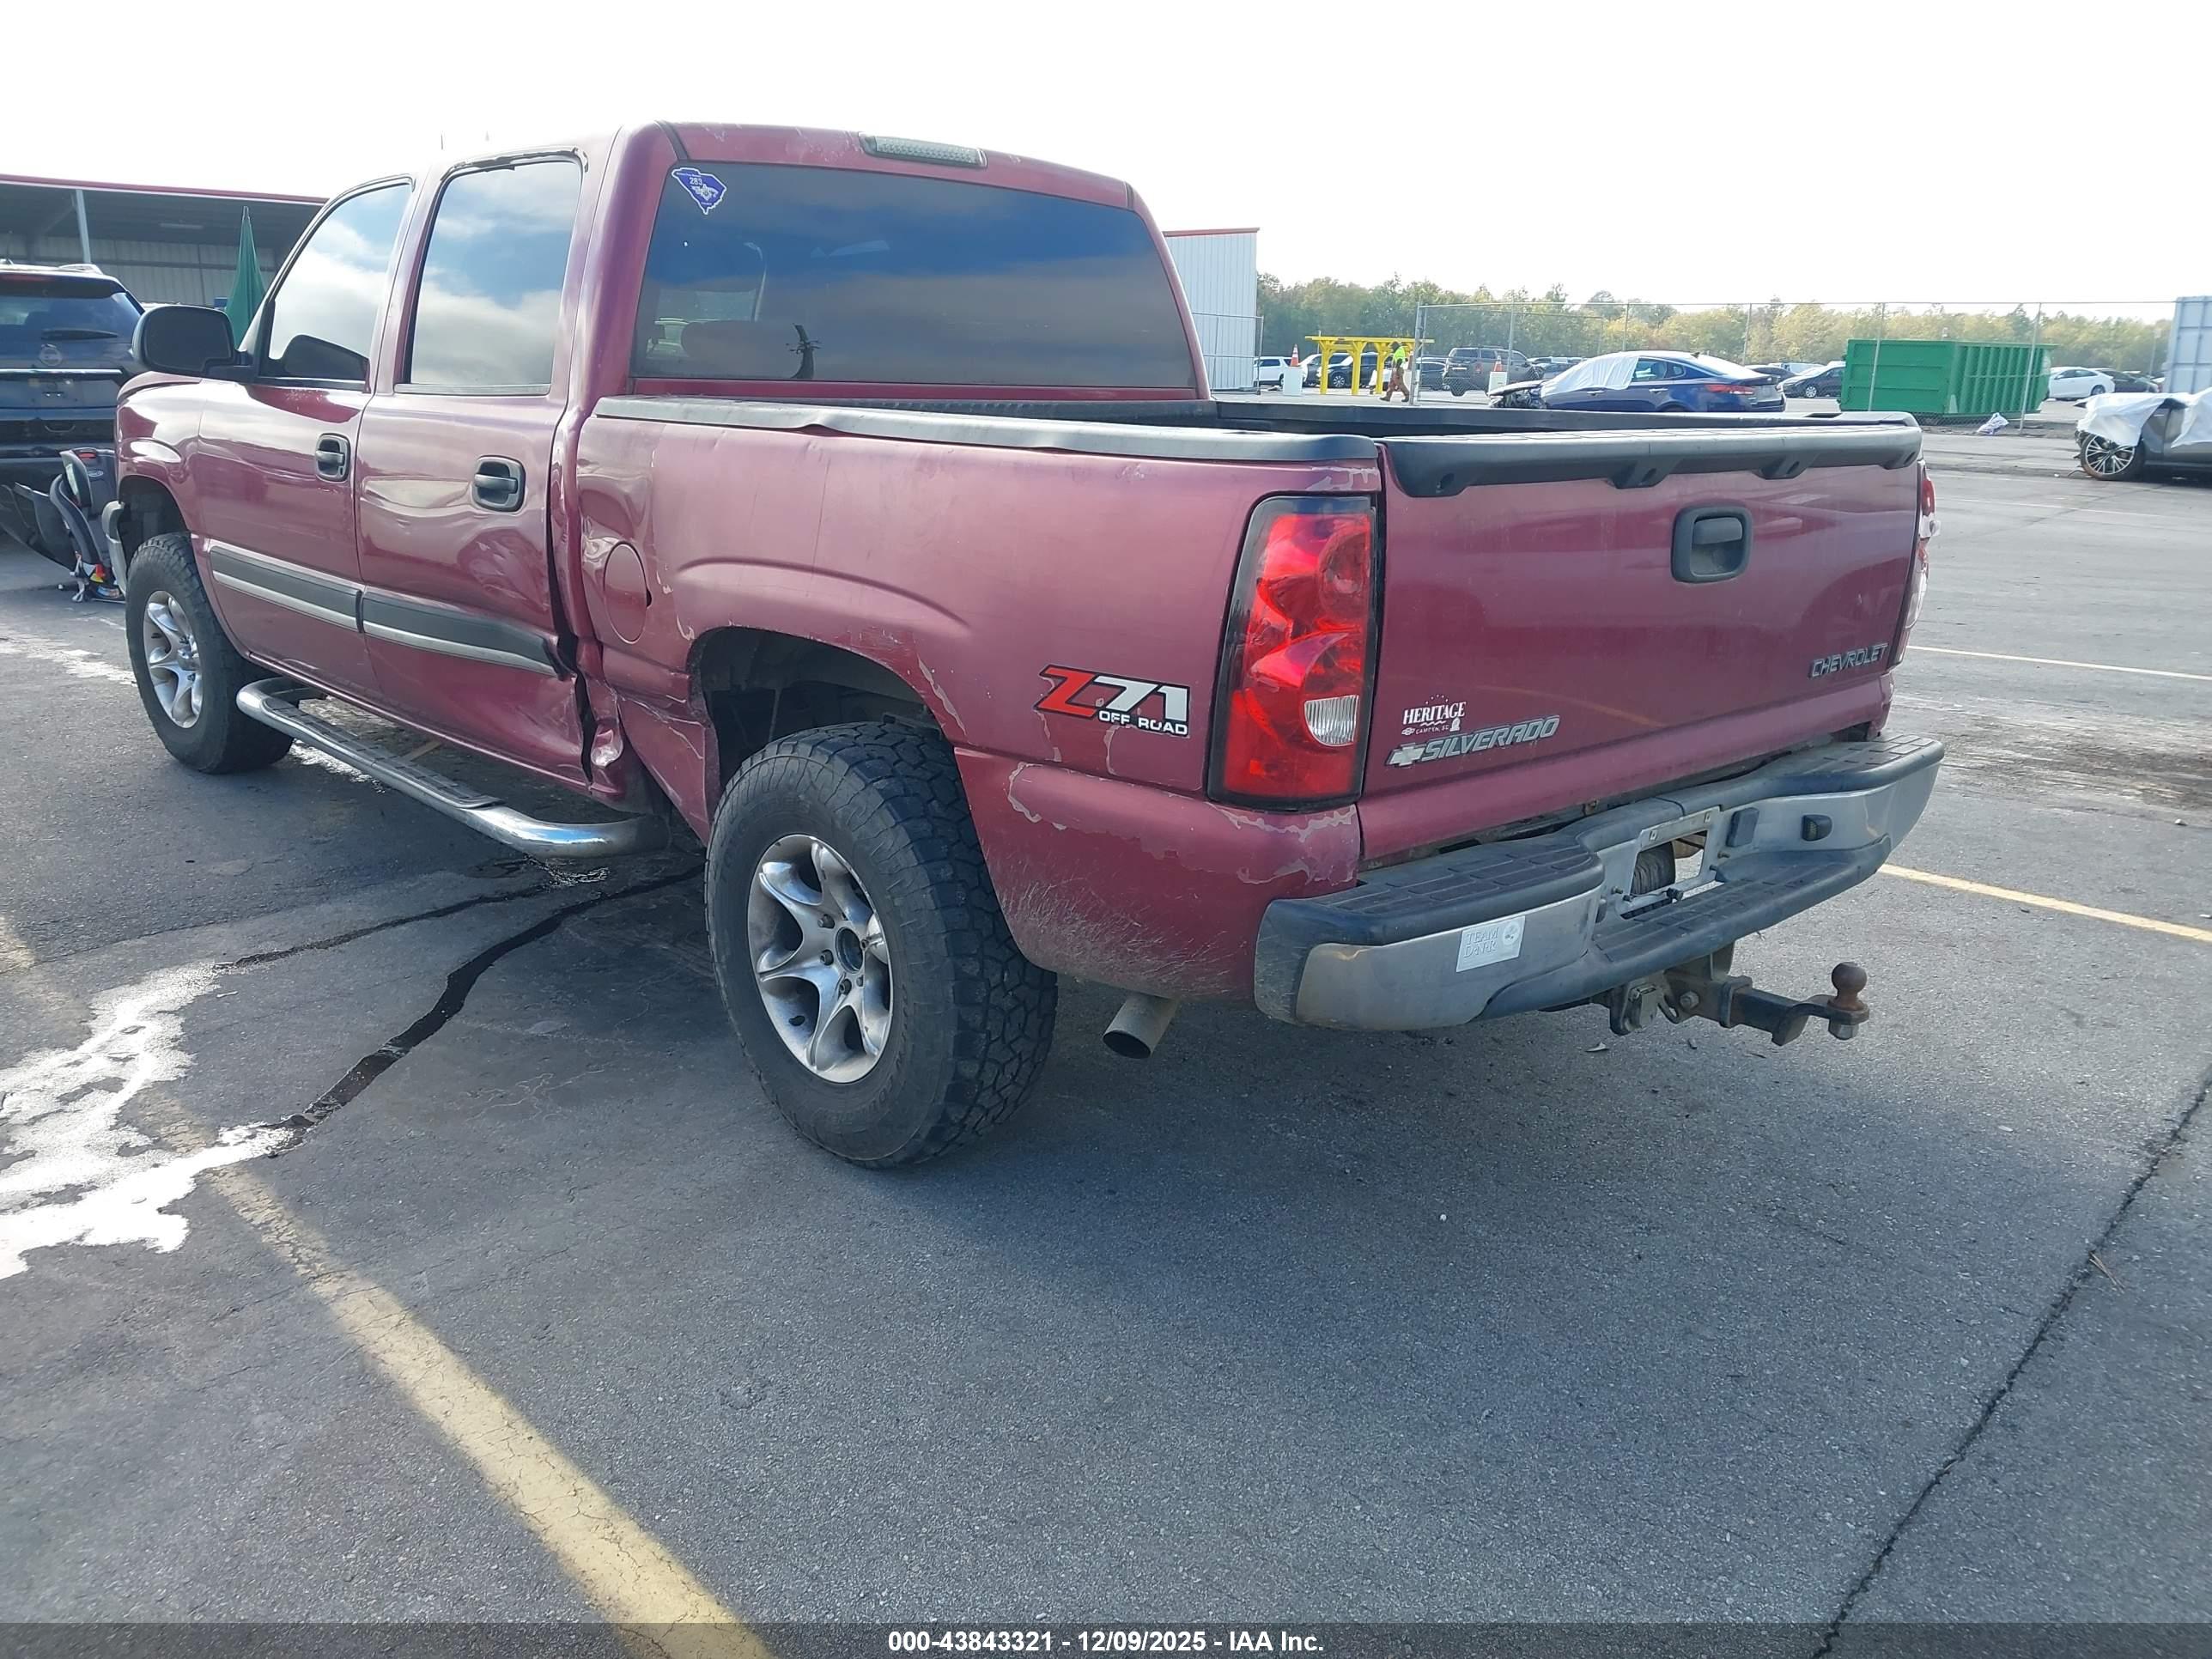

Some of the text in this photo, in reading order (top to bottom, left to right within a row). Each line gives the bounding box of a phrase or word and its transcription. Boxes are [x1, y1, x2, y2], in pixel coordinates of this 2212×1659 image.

[1811, 642, 1888, 678] CHEVROLET
[1034, 665, 1190, 722] Z71
[1098, 710, 1188, 735] OFF ROAD
[1402, 702, 1467, 726] HERITAGE
[1421, 715, 1559, 762] SILVERADO
